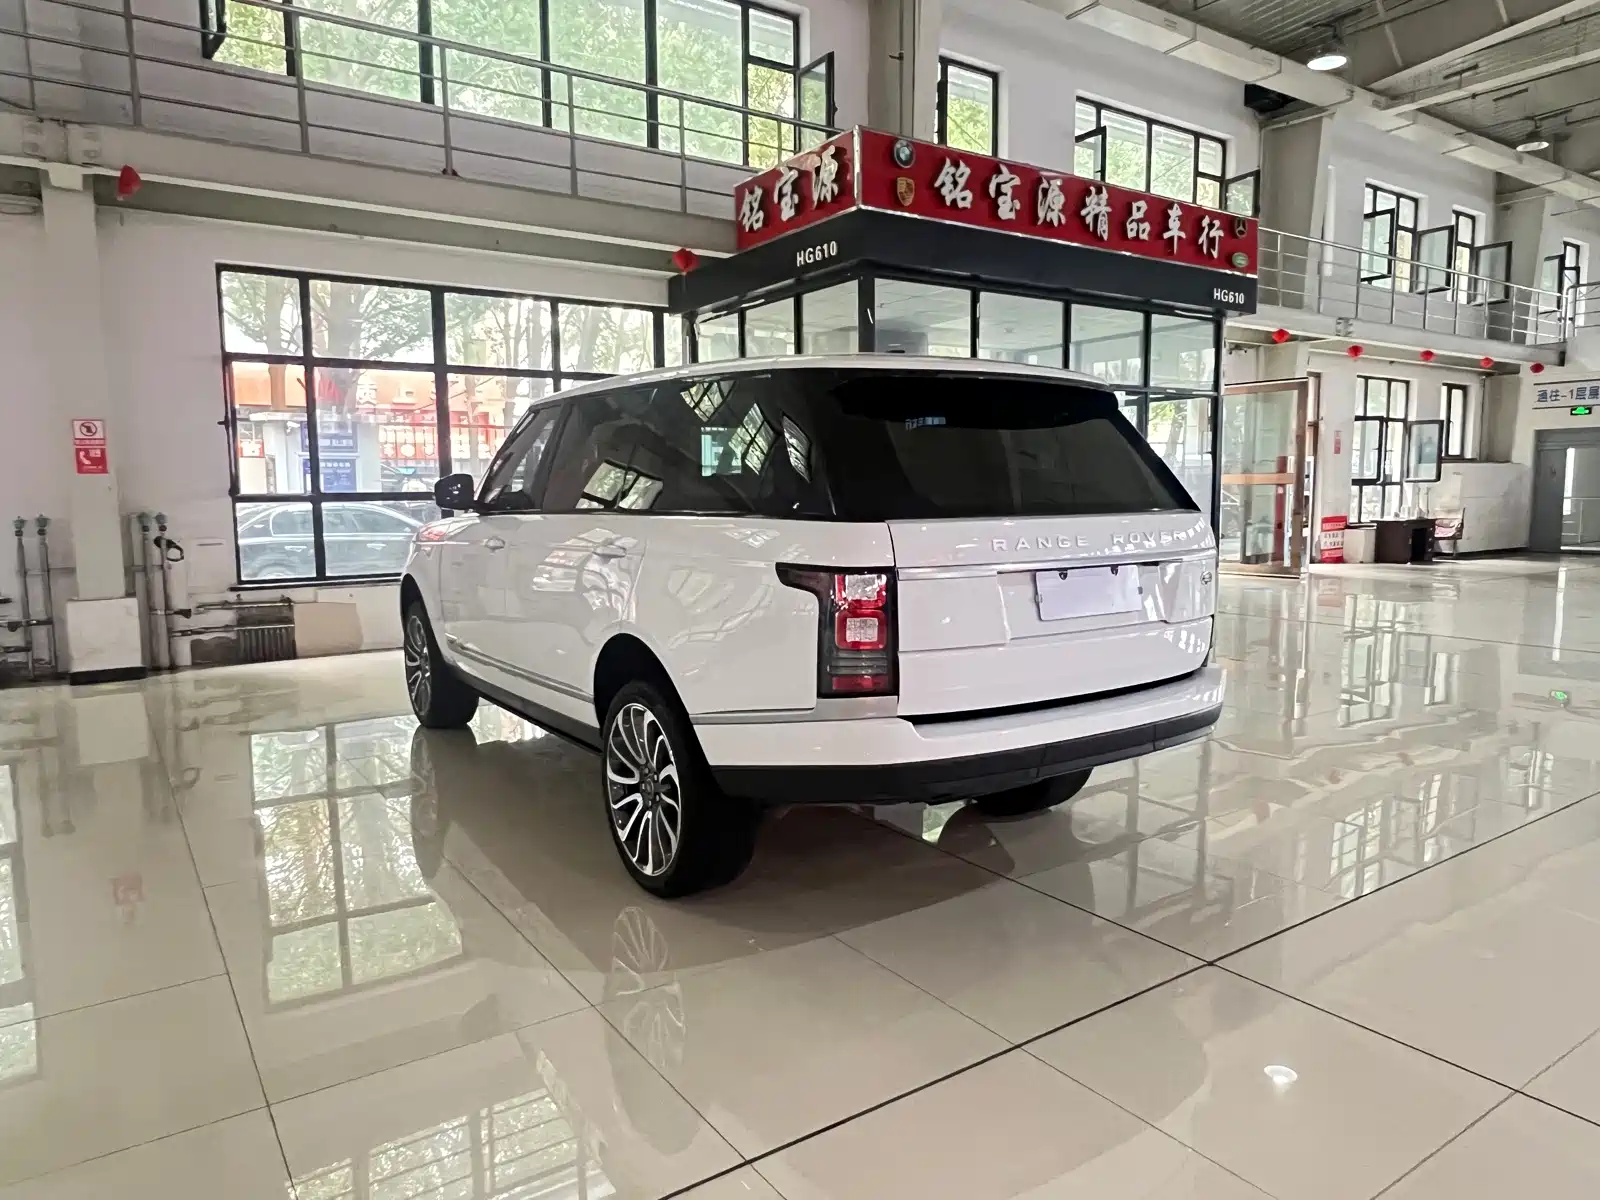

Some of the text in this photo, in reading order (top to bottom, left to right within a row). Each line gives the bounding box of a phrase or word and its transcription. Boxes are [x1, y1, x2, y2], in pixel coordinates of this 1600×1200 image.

[738, 144, 839, 231] 铭宝源
[934, 156, 1224, 259] 铭宝源精品车行
[796, 241, 837, 267] HG610
[1213, 287, 1245, 304] HG610
[991, 529, 1187, 552] RANGE ROVER
